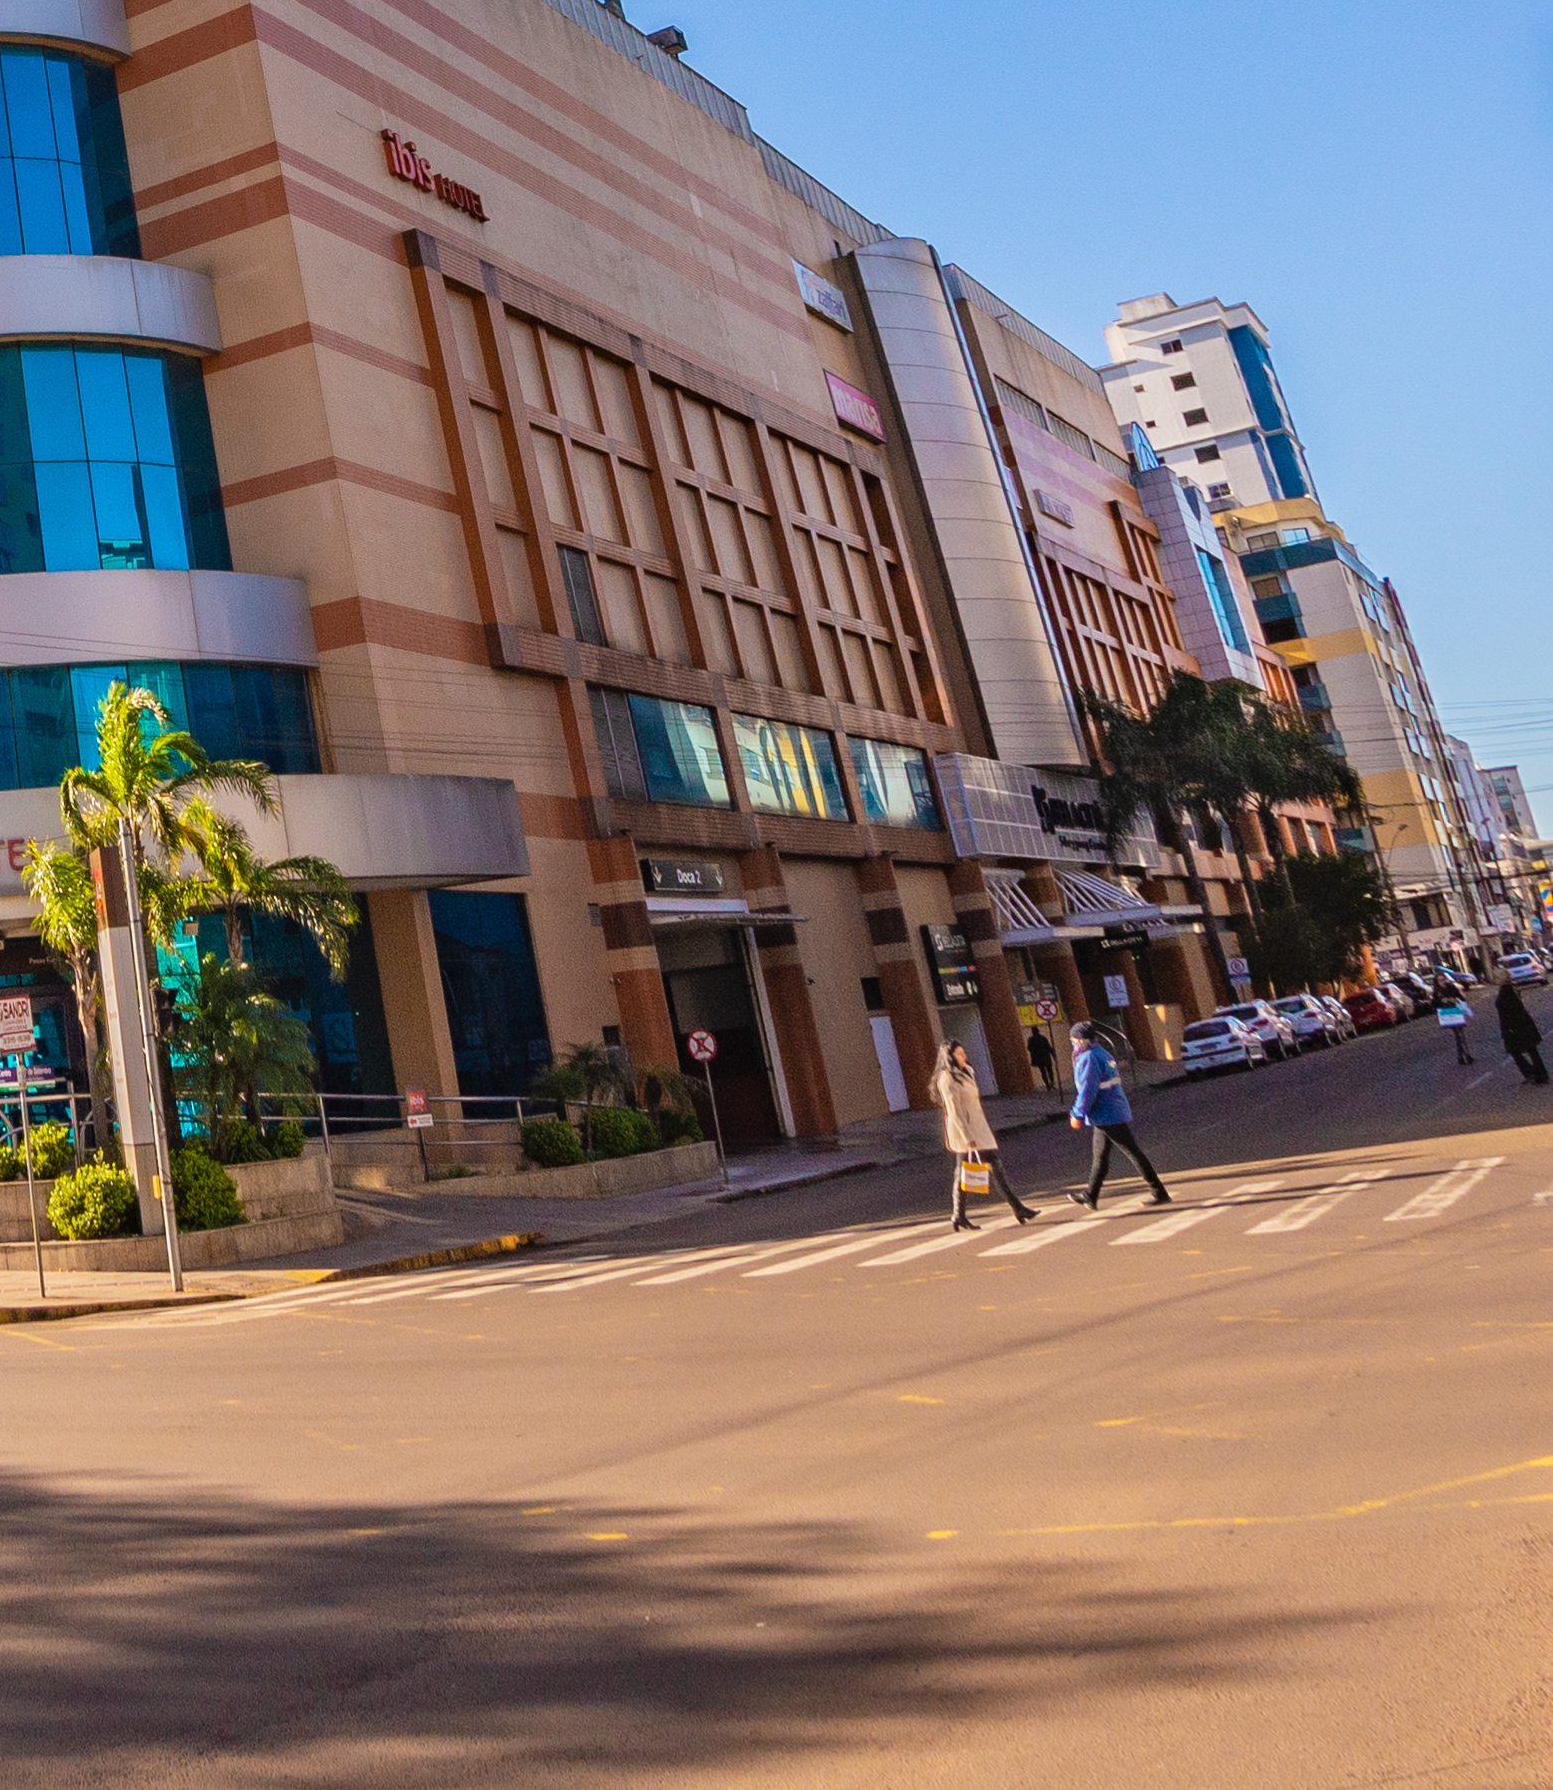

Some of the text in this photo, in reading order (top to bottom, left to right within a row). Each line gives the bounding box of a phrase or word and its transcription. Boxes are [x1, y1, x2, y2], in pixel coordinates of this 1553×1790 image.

[380, 128, 435, 194] ibis
[676, 868, 703, 885] Doca 2
